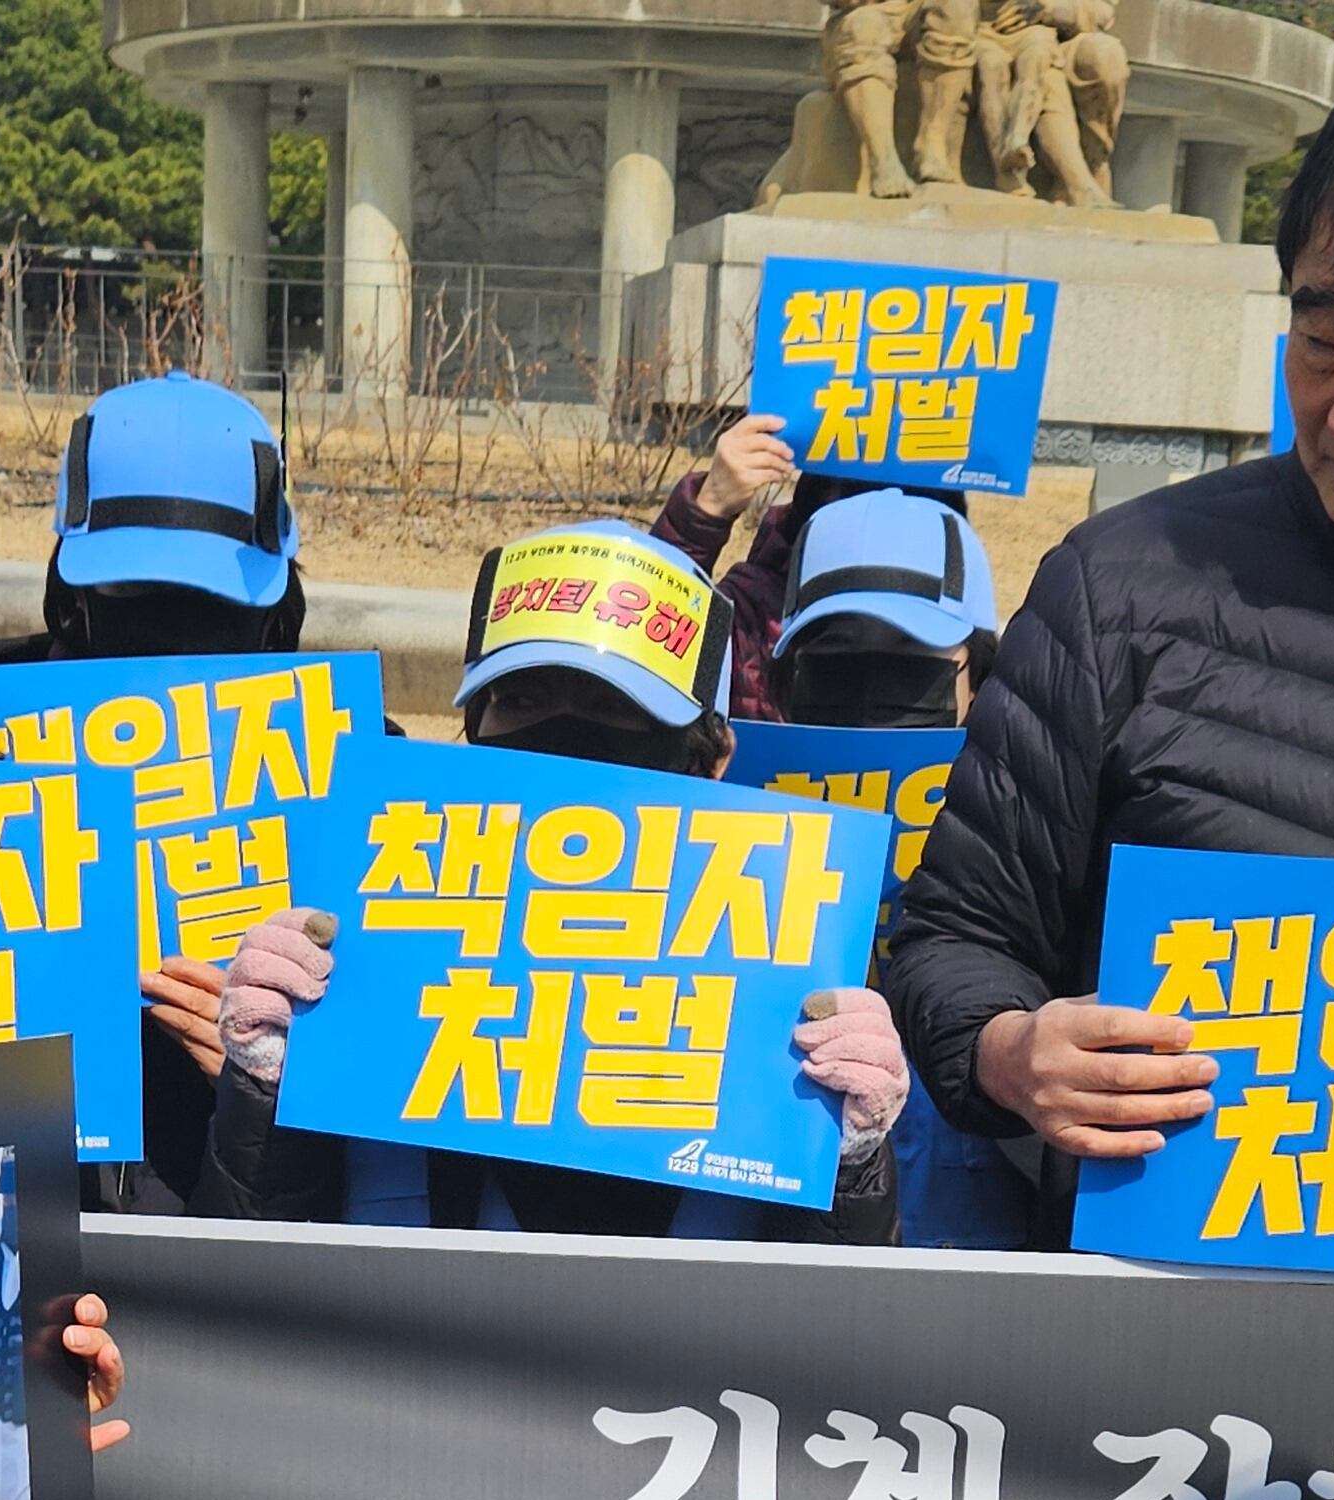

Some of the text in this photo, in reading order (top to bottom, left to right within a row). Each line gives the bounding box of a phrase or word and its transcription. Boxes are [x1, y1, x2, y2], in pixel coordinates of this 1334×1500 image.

[781, 280, 1035, 372] 책임자
[804, 375, 980, 465] 처벌
[490, 577, 699, 660] 방치된 유해
[135, 815, 292, 974] 벌
[356, 800, 843, 966] 책임자
[401, 967, 737, 1129] 처벌
